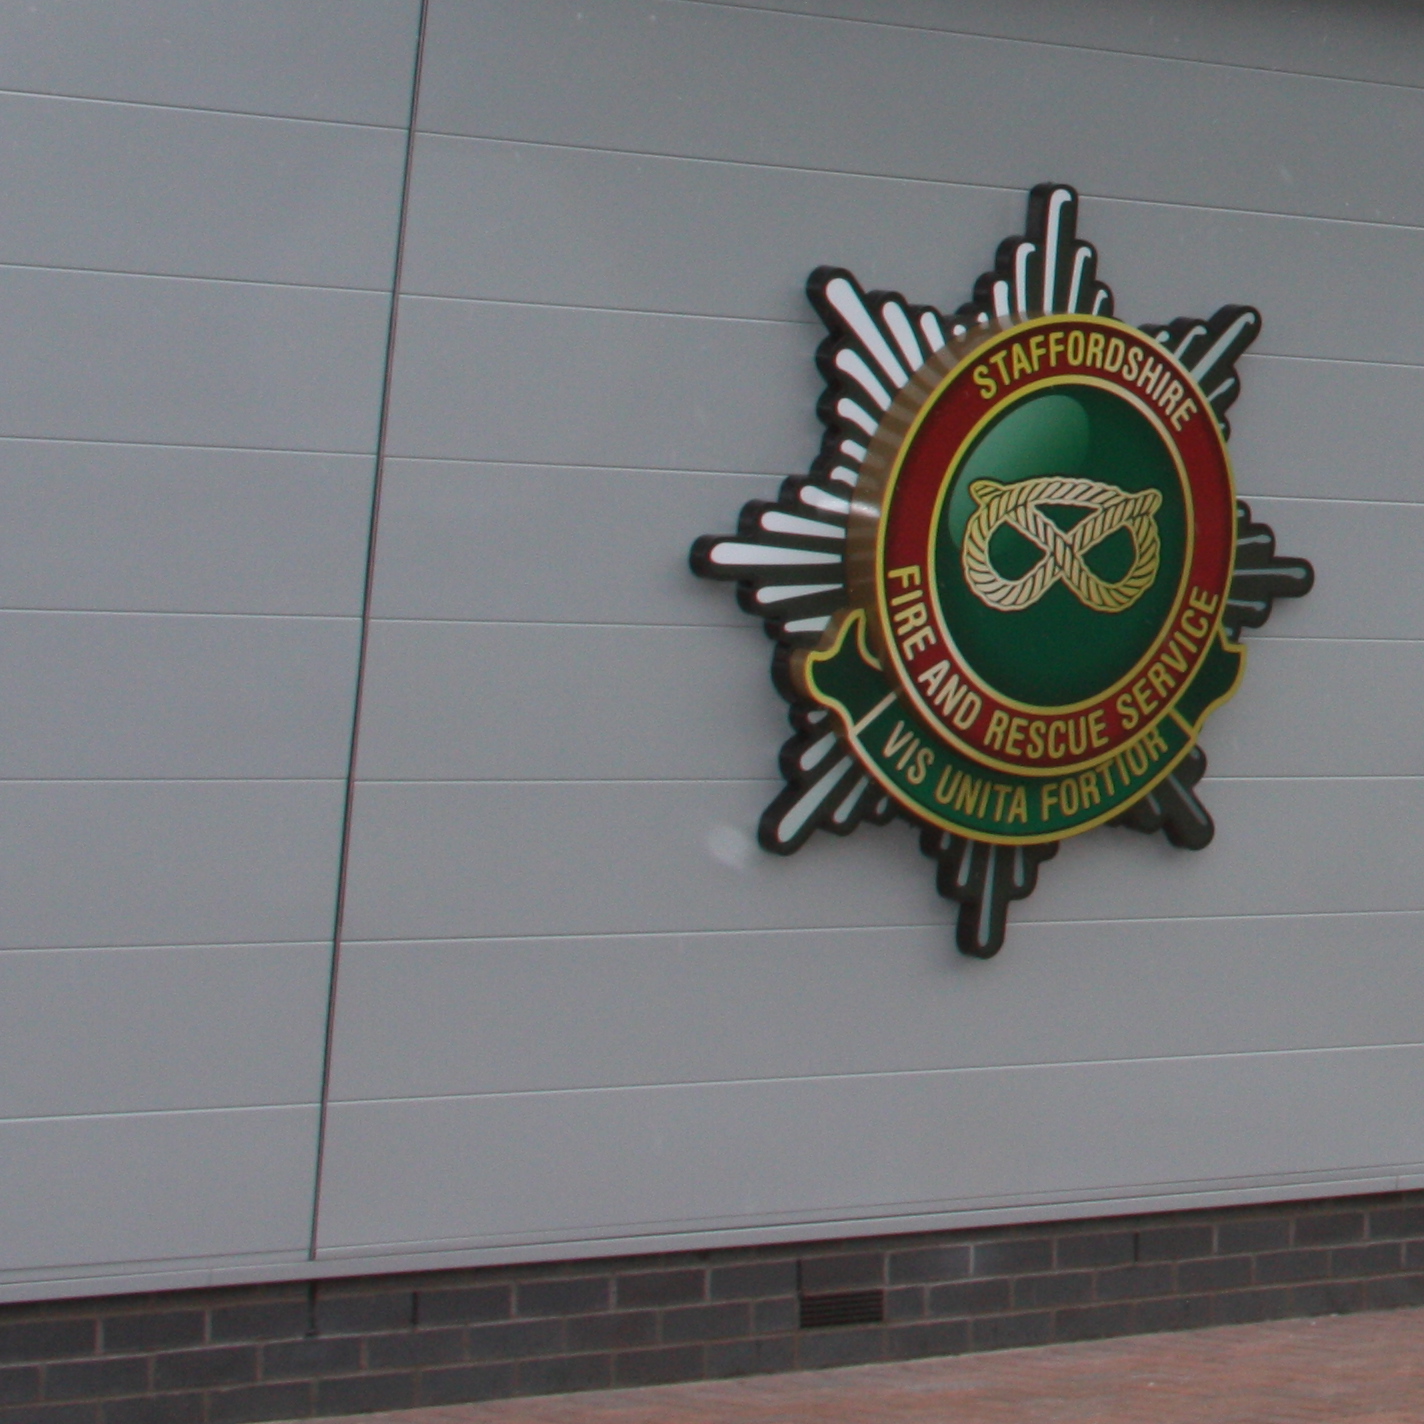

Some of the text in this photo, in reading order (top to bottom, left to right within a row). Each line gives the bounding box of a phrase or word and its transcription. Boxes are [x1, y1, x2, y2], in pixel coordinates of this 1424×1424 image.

[973, 330, 1197, 432] STAFFORDSHIRE
[888, 565, 1219, 759] FIRE AND RESCUE SERVICE
[882, 720, 1168, 824] VIS UNITA FORTIOR
